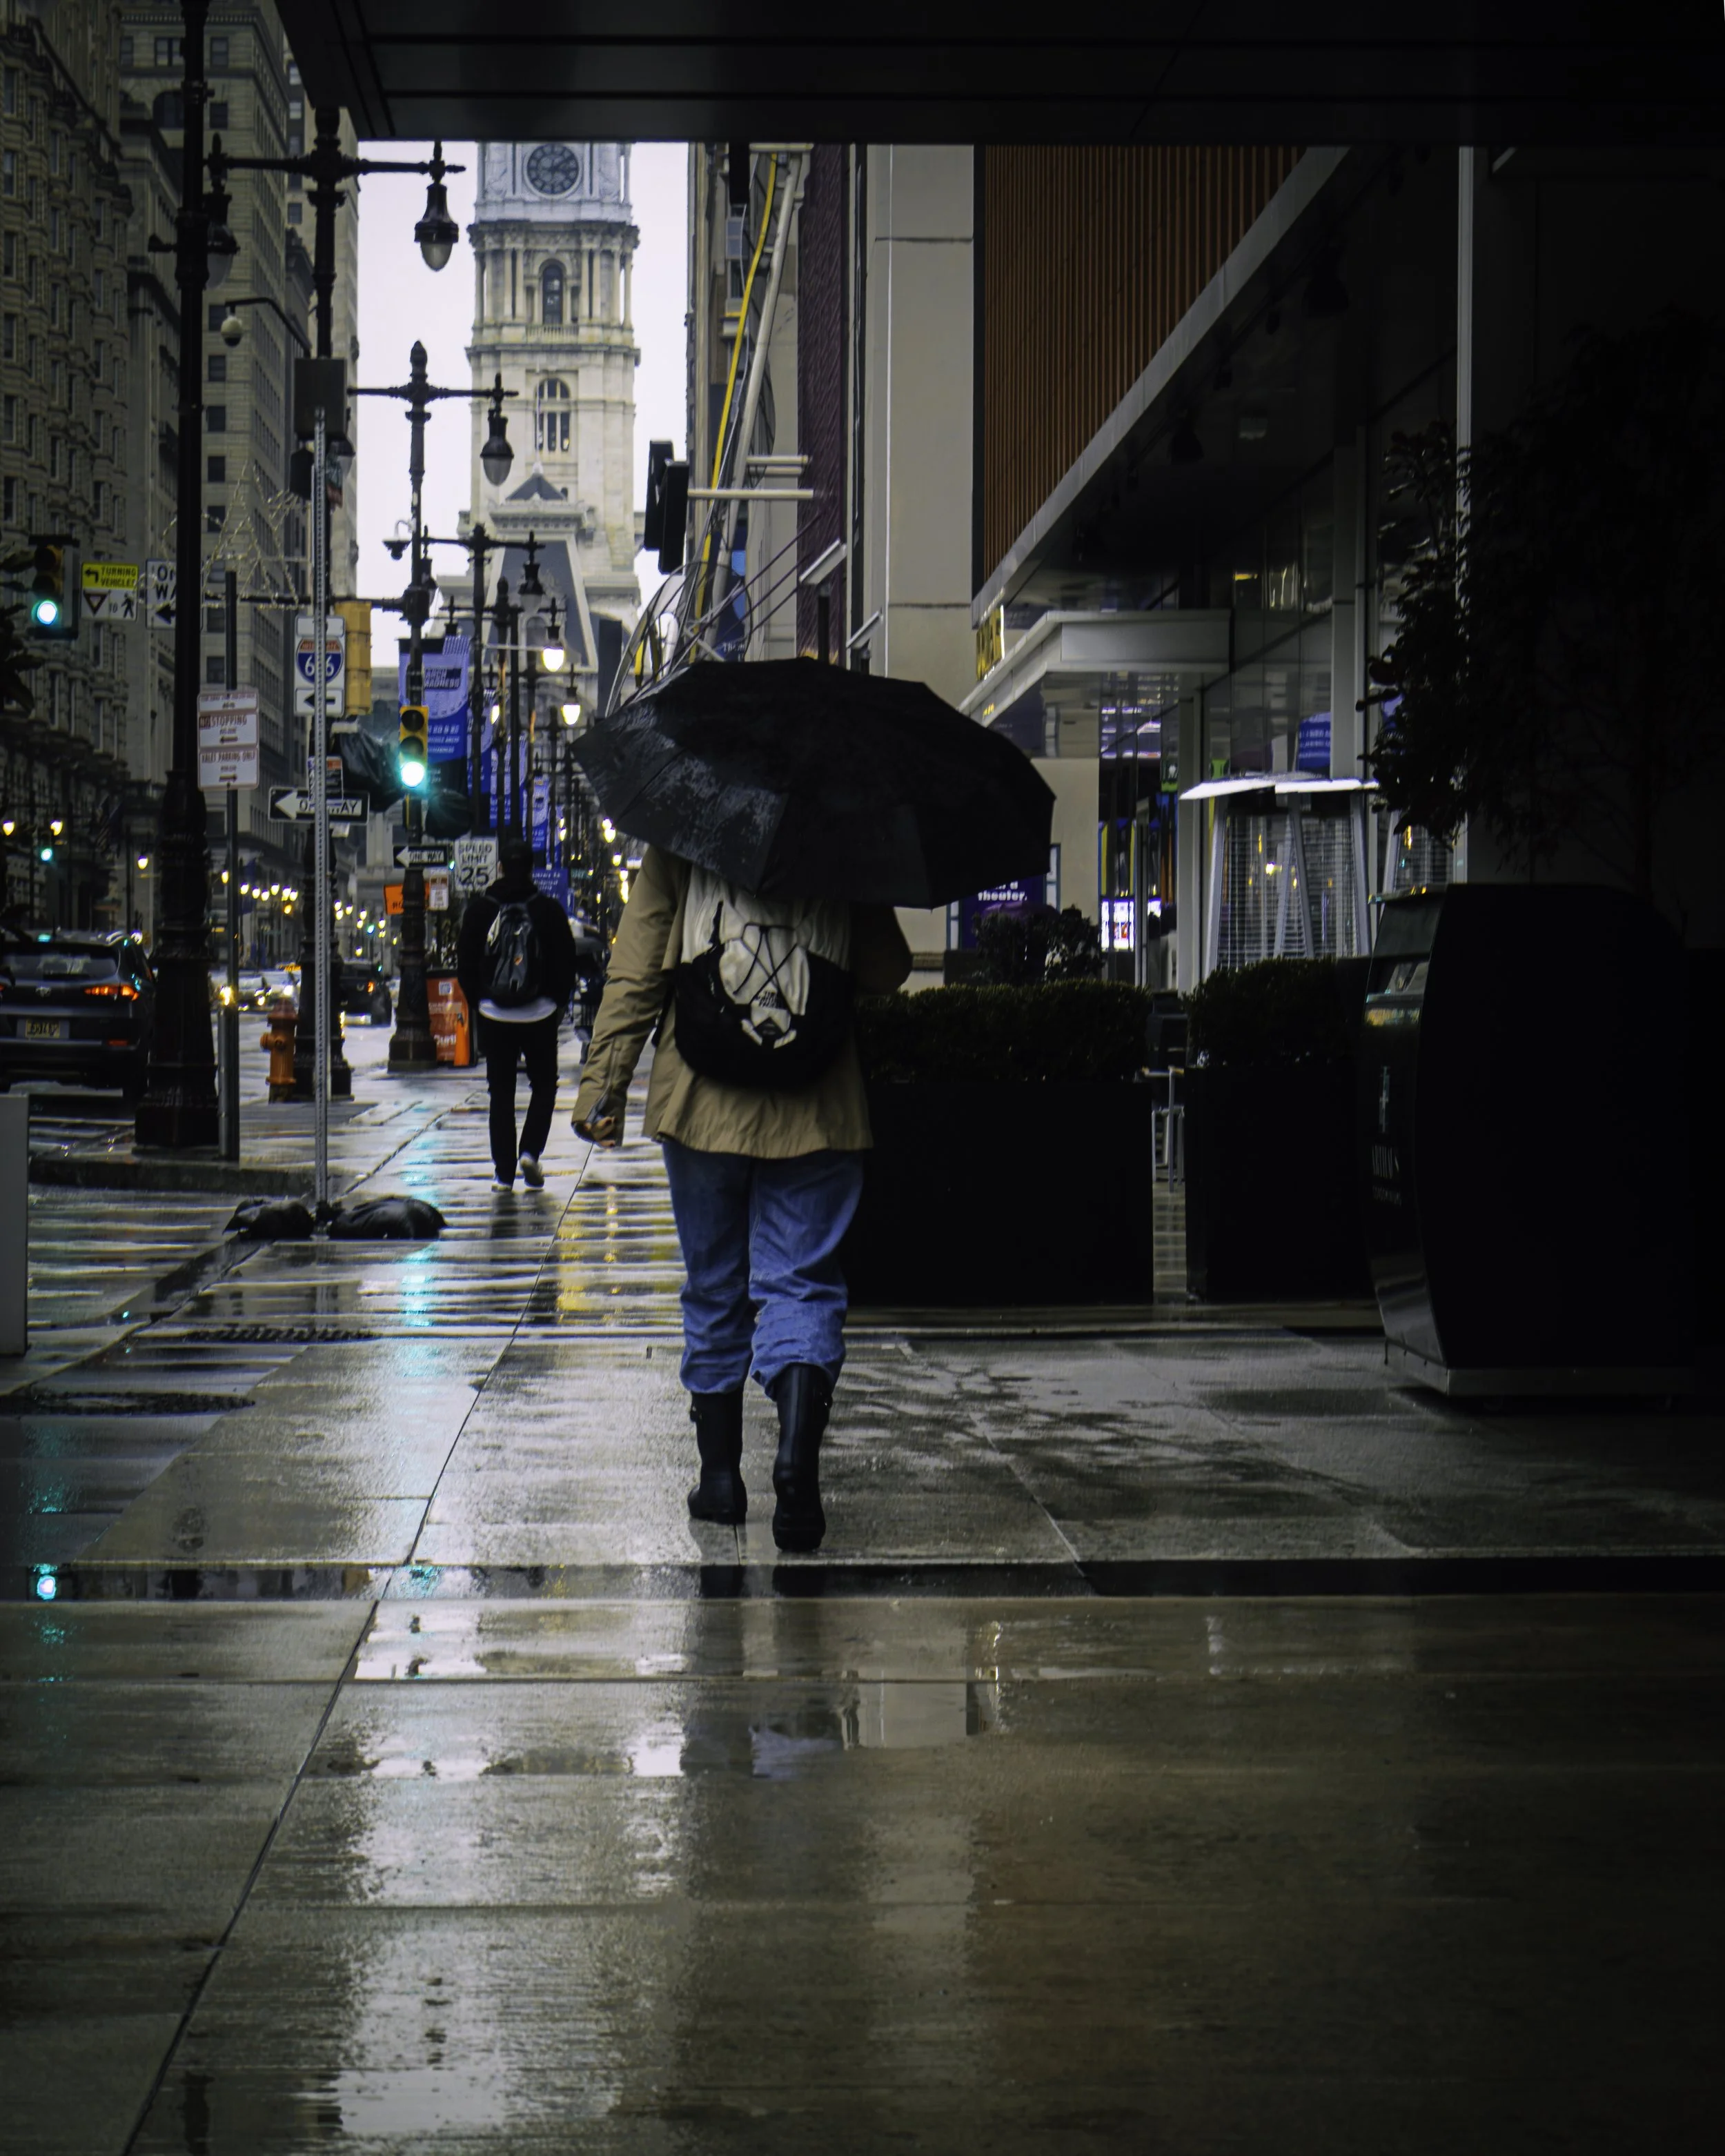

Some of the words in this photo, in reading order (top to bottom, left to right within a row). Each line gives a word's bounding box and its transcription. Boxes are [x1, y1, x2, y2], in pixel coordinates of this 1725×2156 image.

[305, 655, 335, 677] 66
[210, 715, 247, 727] STOPPING
[218, 751, 240, 762] PARKING
[460, 842, 493, 853] SPEED
[410, 850, 421, 862] ONE
[428, 851, 443, 862] WAY
[462, 855, 487, 864] LIMIT
[461, 867, 489, 886] 25
[978, 889, 1027, 901] theater.
